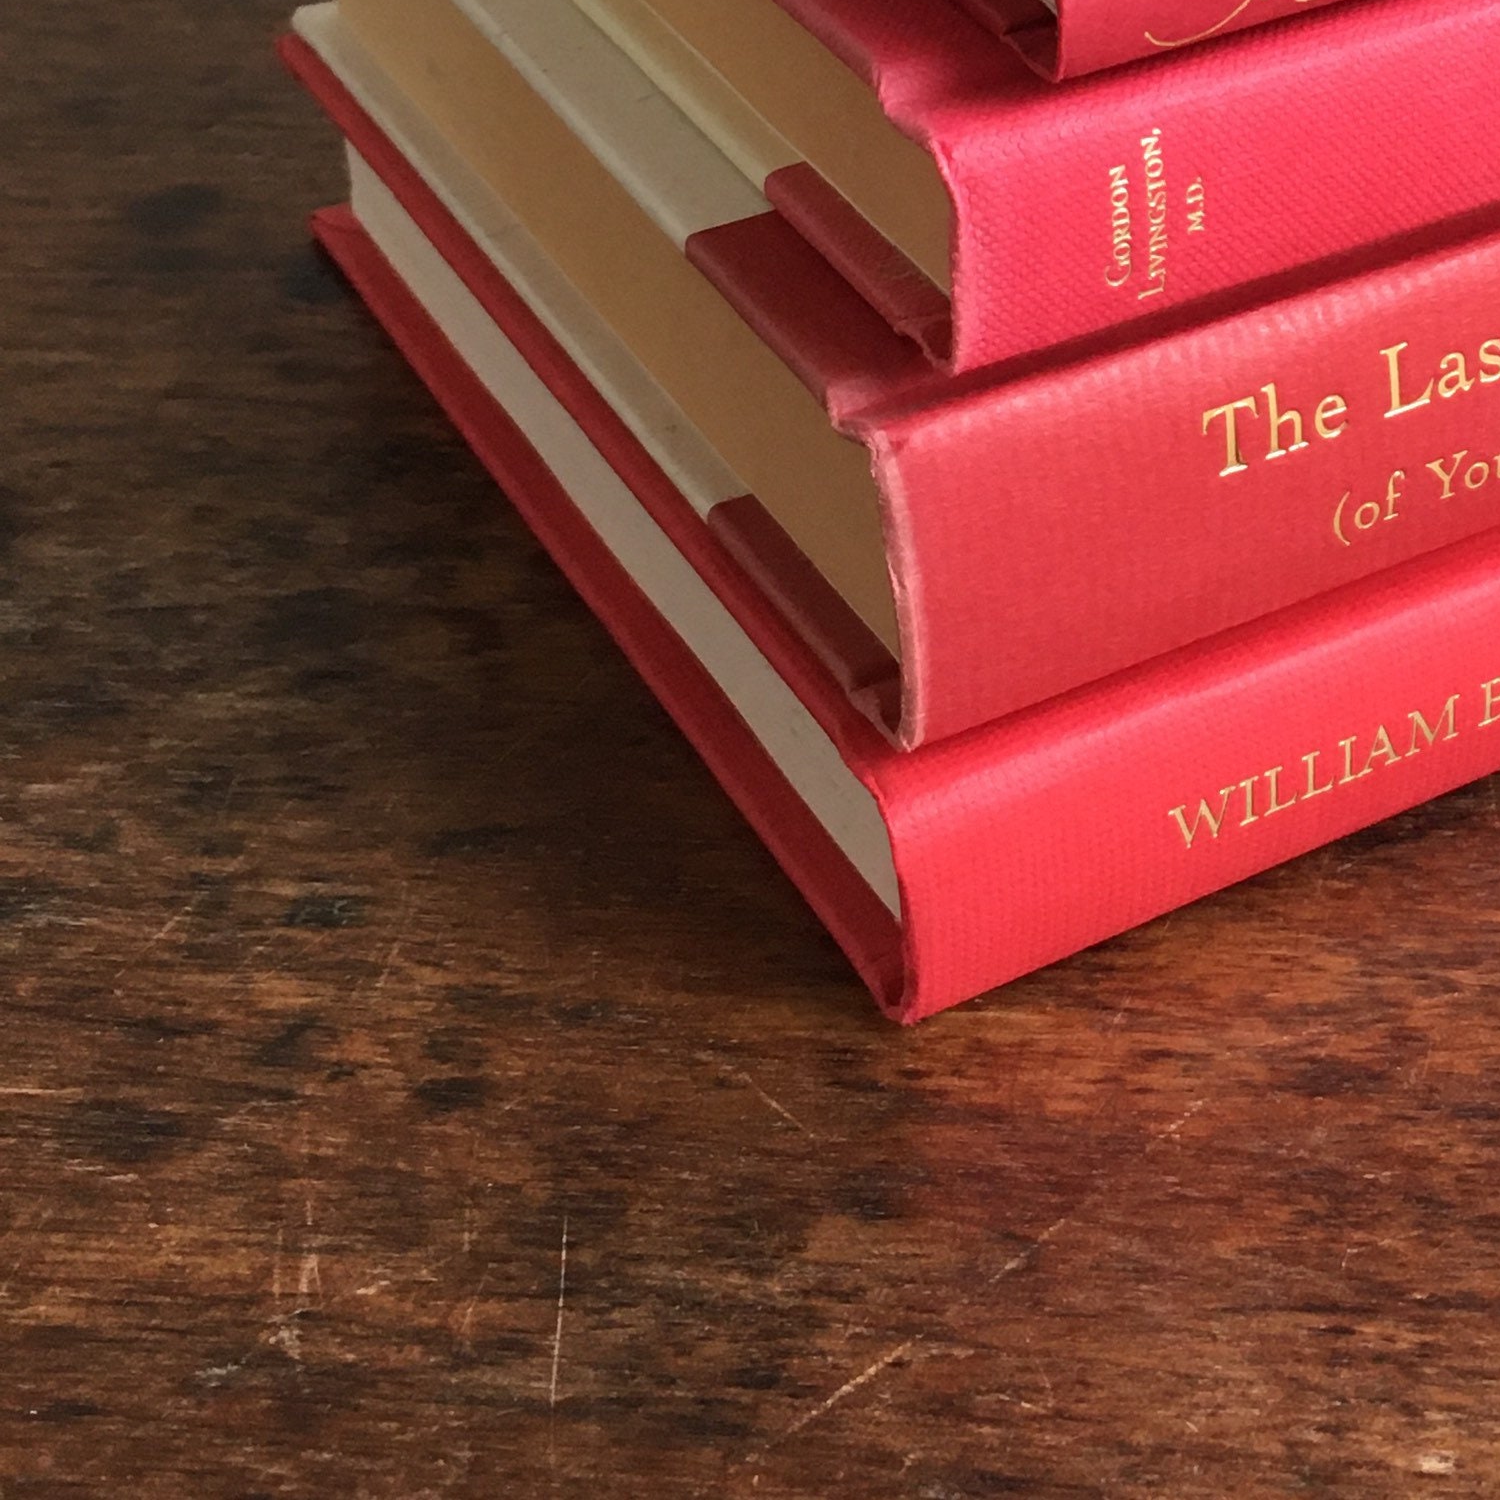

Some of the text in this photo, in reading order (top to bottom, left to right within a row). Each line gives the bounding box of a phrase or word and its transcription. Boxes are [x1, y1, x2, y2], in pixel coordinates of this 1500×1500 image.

[1104, 164, 1132, 287] GORDON
[1202, 383, 1348, 478] The
[1332, 470, 1407, 547] (of
[1168, 694, 1461, 850] WILLIAM
